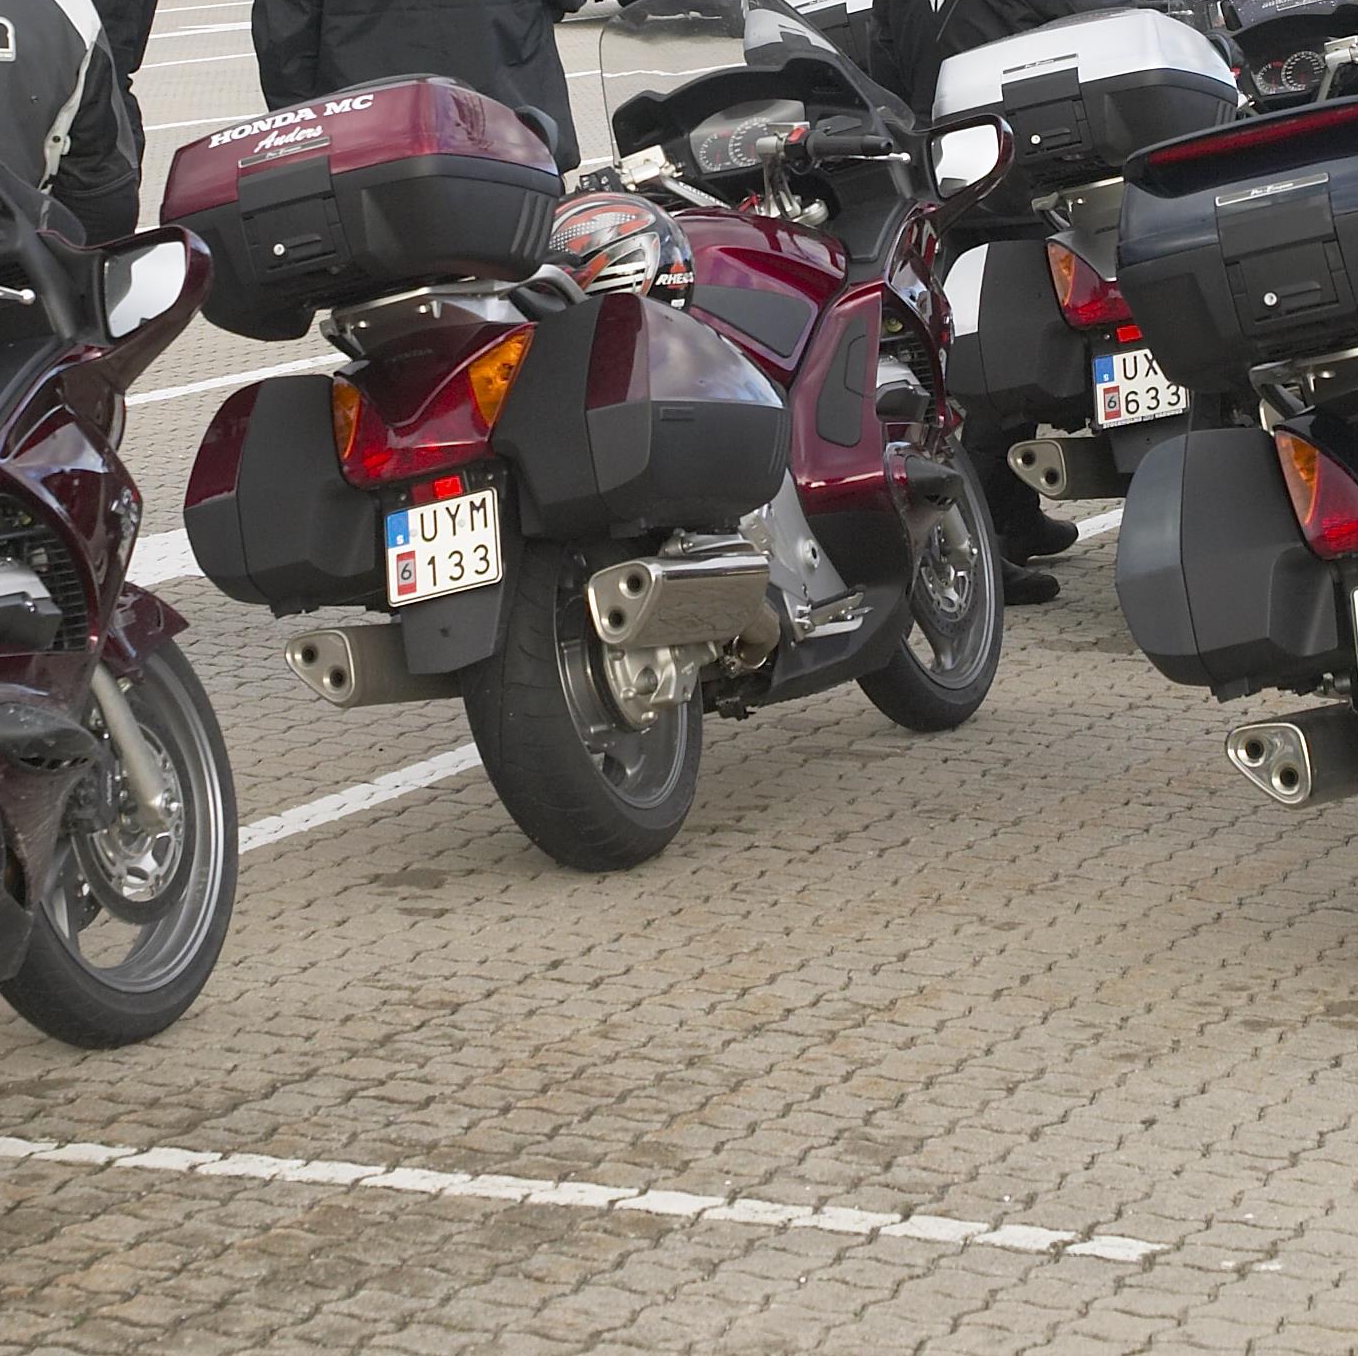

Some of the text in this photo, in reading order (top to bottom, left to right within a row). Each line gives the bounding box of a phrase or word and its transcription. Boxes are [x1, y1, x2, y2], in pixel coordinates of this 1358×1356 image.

[208, 94, 375, 148] HONDA MC
[253, 125, 324, 153] Anders
[1123, 353, 1158, 380] UX
[1107, 396, 1117, 409] 6
[1125, 384, 1181, 414] 633
[420, 497, 488, 542] UYM
[401, 562, 412, 581] 6
[427, 544, 490, 587] 133
